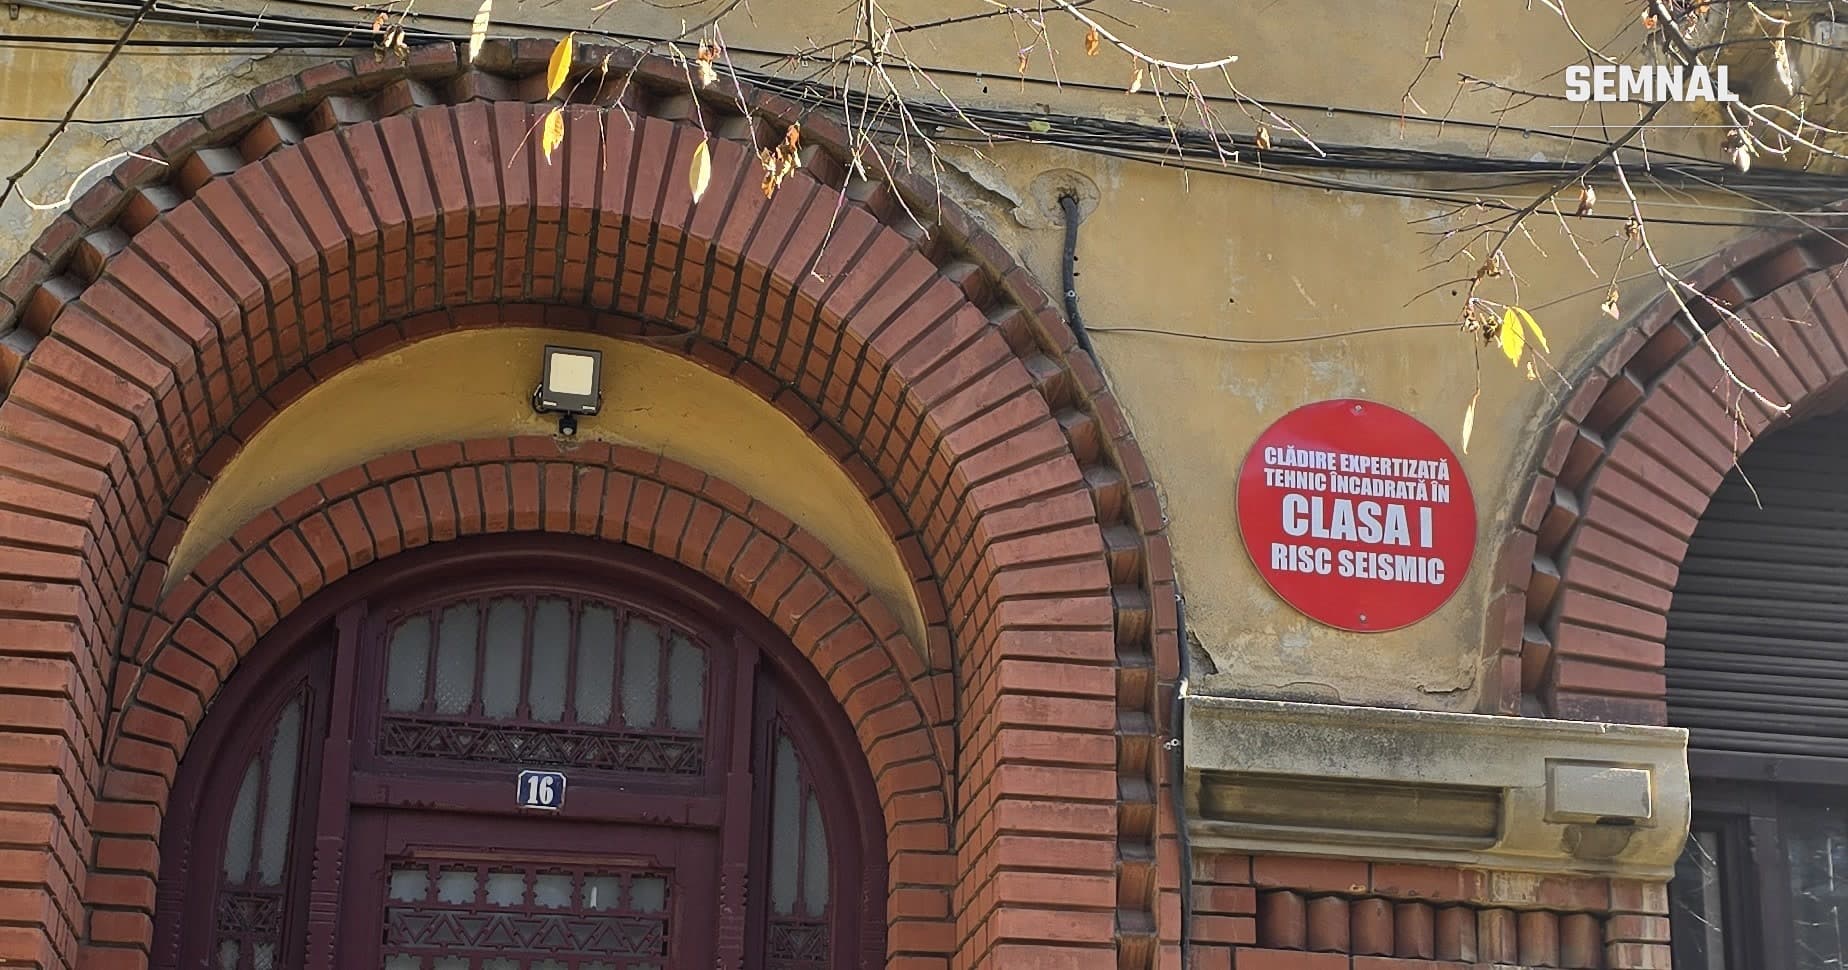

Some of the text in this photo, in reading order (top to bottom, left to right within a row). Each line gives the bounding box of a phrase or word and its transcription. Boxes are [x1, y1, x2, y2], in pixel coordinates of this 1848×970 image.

[1264, 445, 1450, 481] CLĂDIRE EXPERTIZATĂ
[1264, 468, 1450, 503] TEHNIC ÎNCADRATĂ ÎN
[1282, 493, 1433, 548] CLASA I
[1271, 542, 1445, 585] RISC SEISMIC
[527, 775, 554, 804] 16
